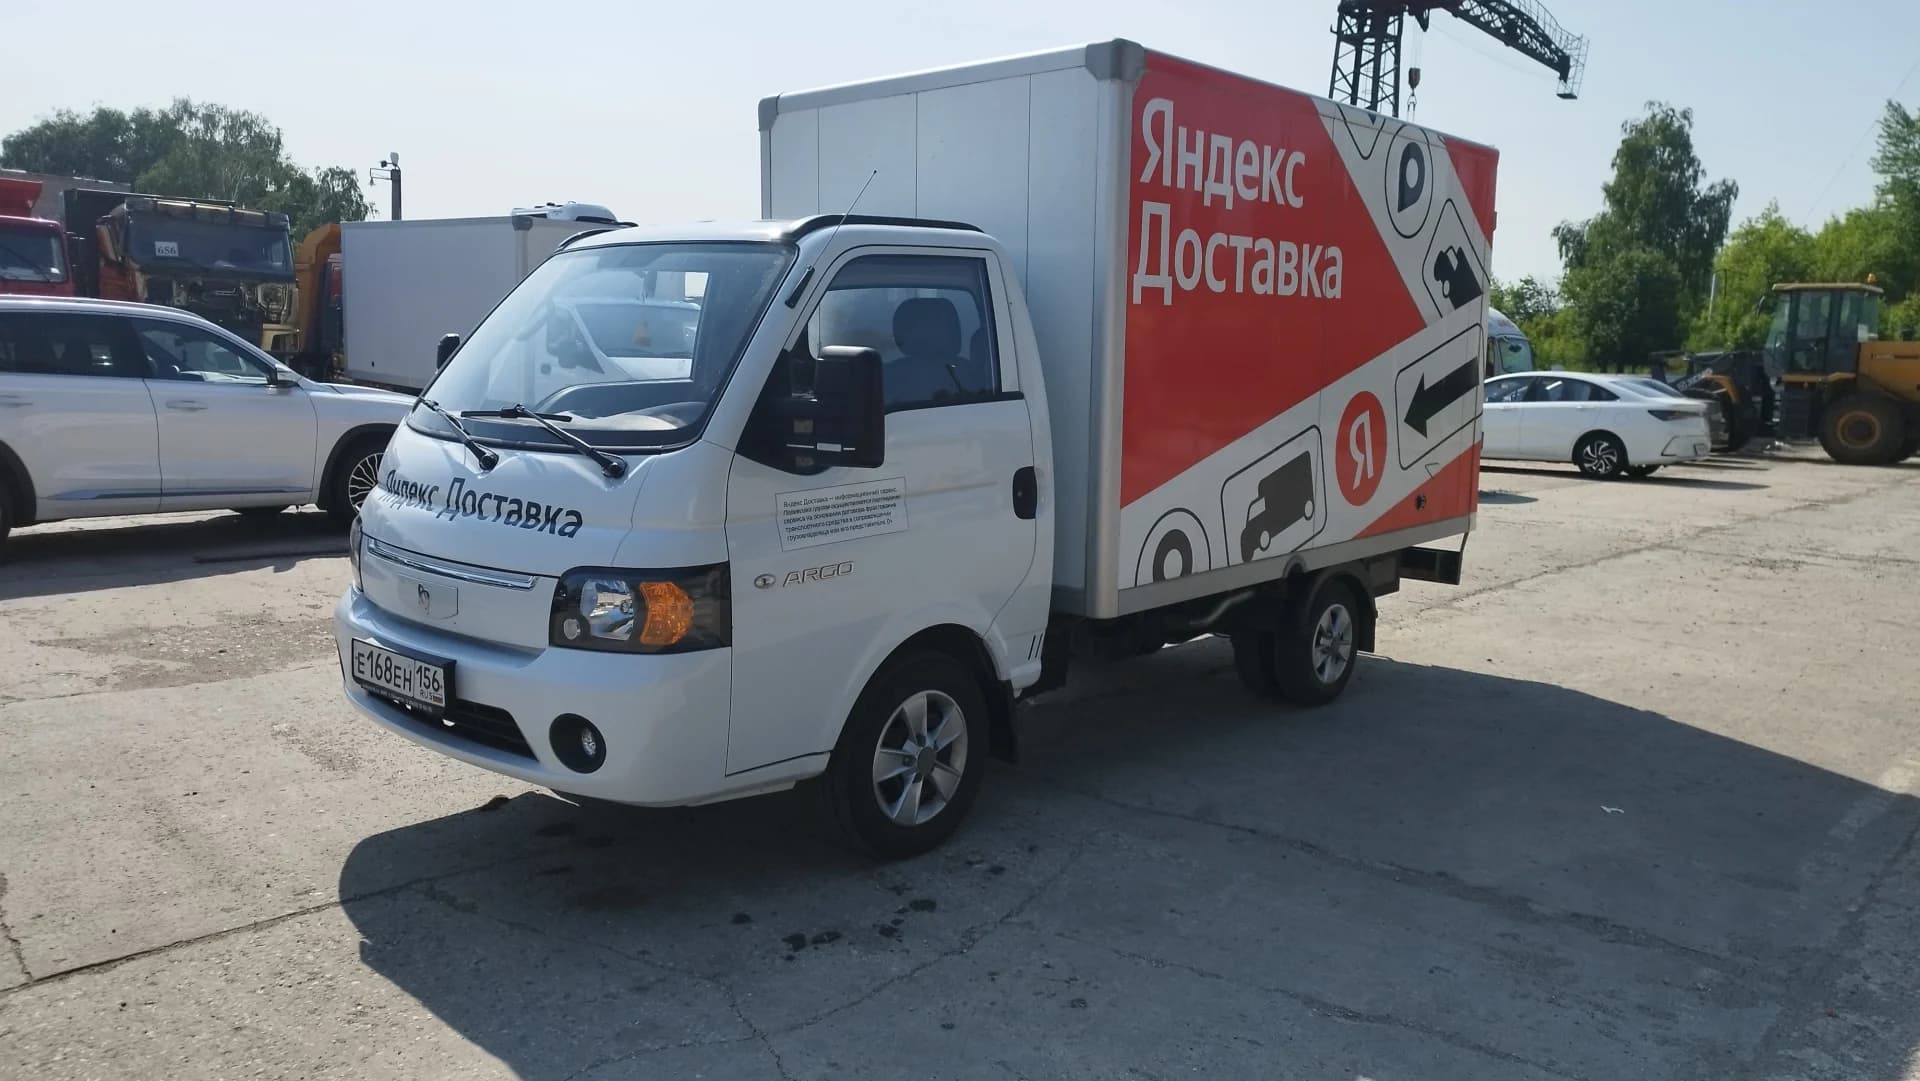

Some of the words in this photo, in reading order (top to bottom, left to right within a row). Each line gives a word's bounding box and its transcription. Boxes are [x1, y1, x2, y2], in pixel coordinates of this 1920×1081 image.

[1140, 98, 1305, 210] Яндекс
[1132, 201, 1343, 305] Доставка
[1350, 409, 1374, 490] Я
[436, 477, 583, 538] Доставка
[782, 561, 854, 587] ARGO
[416, 665, 440, 692] 156
